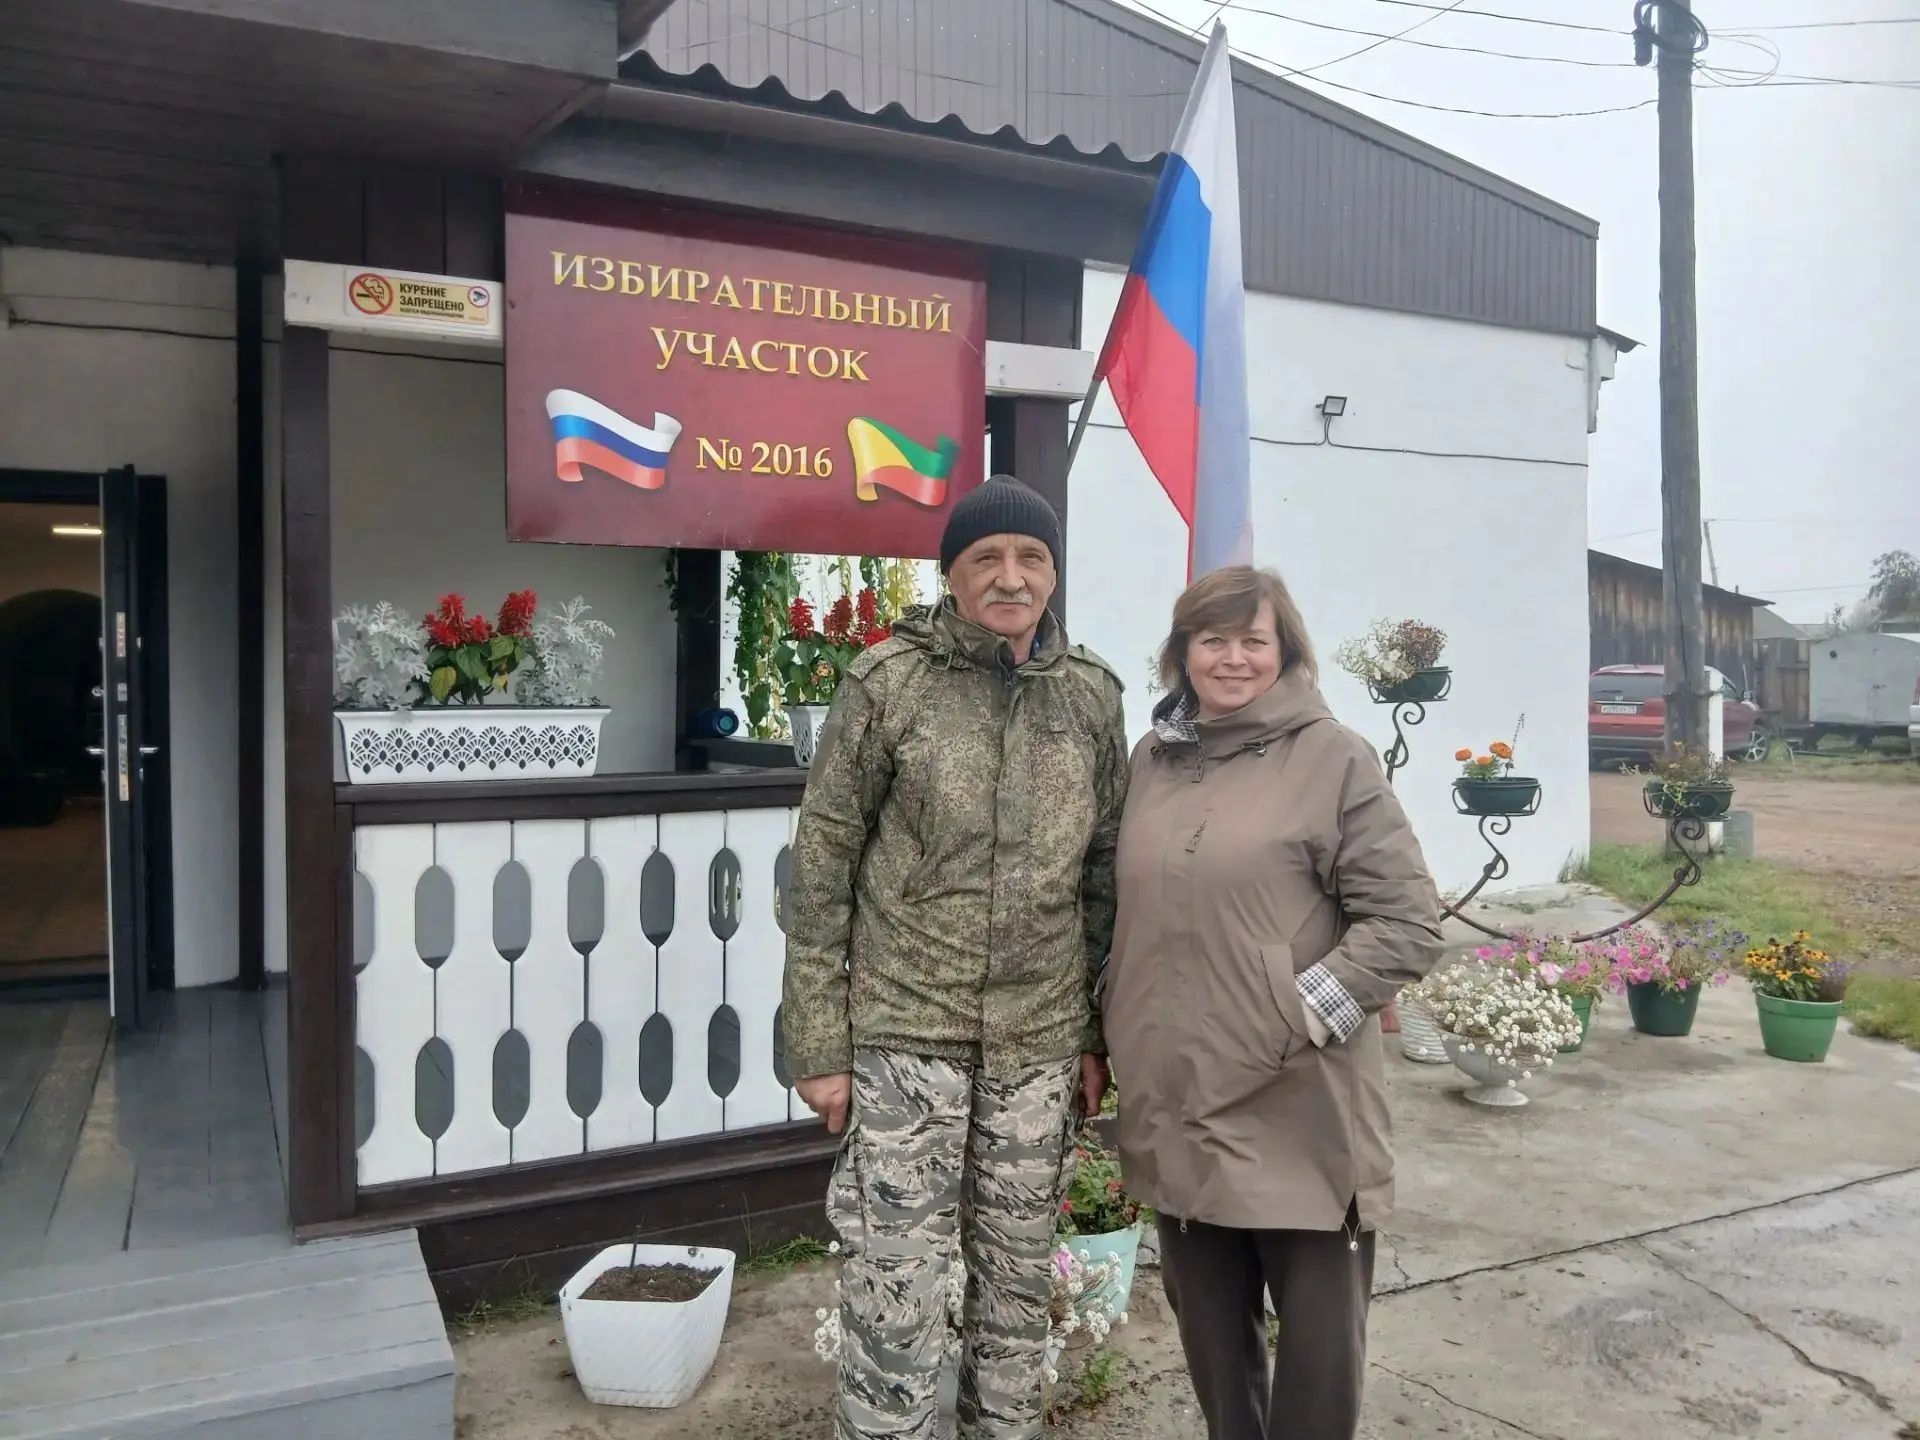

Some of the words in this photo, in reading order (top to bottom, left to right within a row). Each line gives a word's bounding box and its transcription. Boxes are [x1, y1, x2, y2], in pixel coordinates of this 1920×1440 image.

[399, 282, 447, 298] КУРЕНИЕ
[399, 295, 465, 312] ЗАПРЕЩЕНО
[550, 250, 953, 333] ИЗБИРАТЕЛЬНЫЙ
[650, 327, 871, 382] УЧАСТОК
[696, 437, 743, 473] №
[751, 441, 833, 478] 2016
